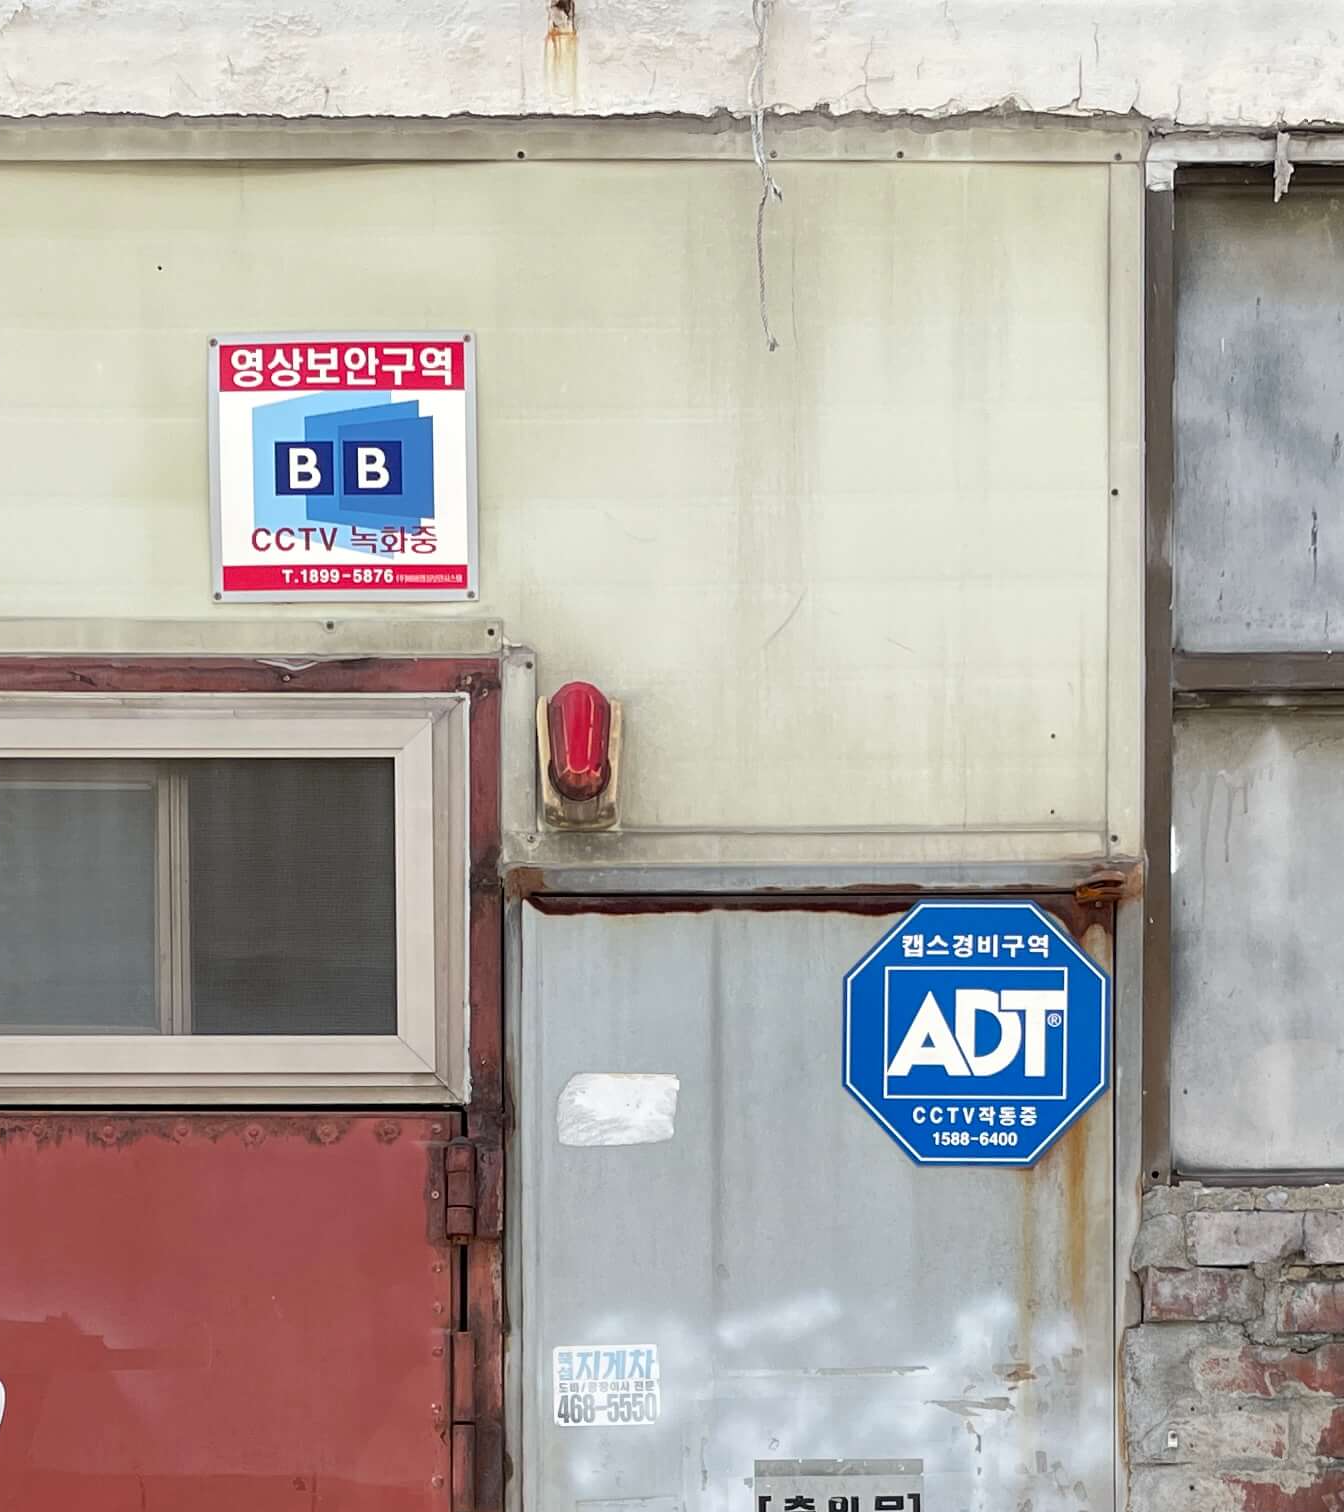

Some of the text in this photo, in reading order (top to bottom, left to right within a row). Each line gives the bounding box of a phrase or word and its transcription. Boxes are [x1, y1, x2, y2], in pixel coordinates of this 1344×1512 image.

[230, 347, 453, 388] 영상보안구역
[251, 525, 438, 554] CCTV 녹화중
[282, 568, 394, 584] T.1899-5876
[901, 934, 1050, 958] 캡스경비구역
[886, 989, 1065, 1077] ADT
[932, 1131, 1018, 1147] 1588-6400
[576, 1349, 656, 1380] 지게차
[557, 1393, 657, 1424] 468-5550
